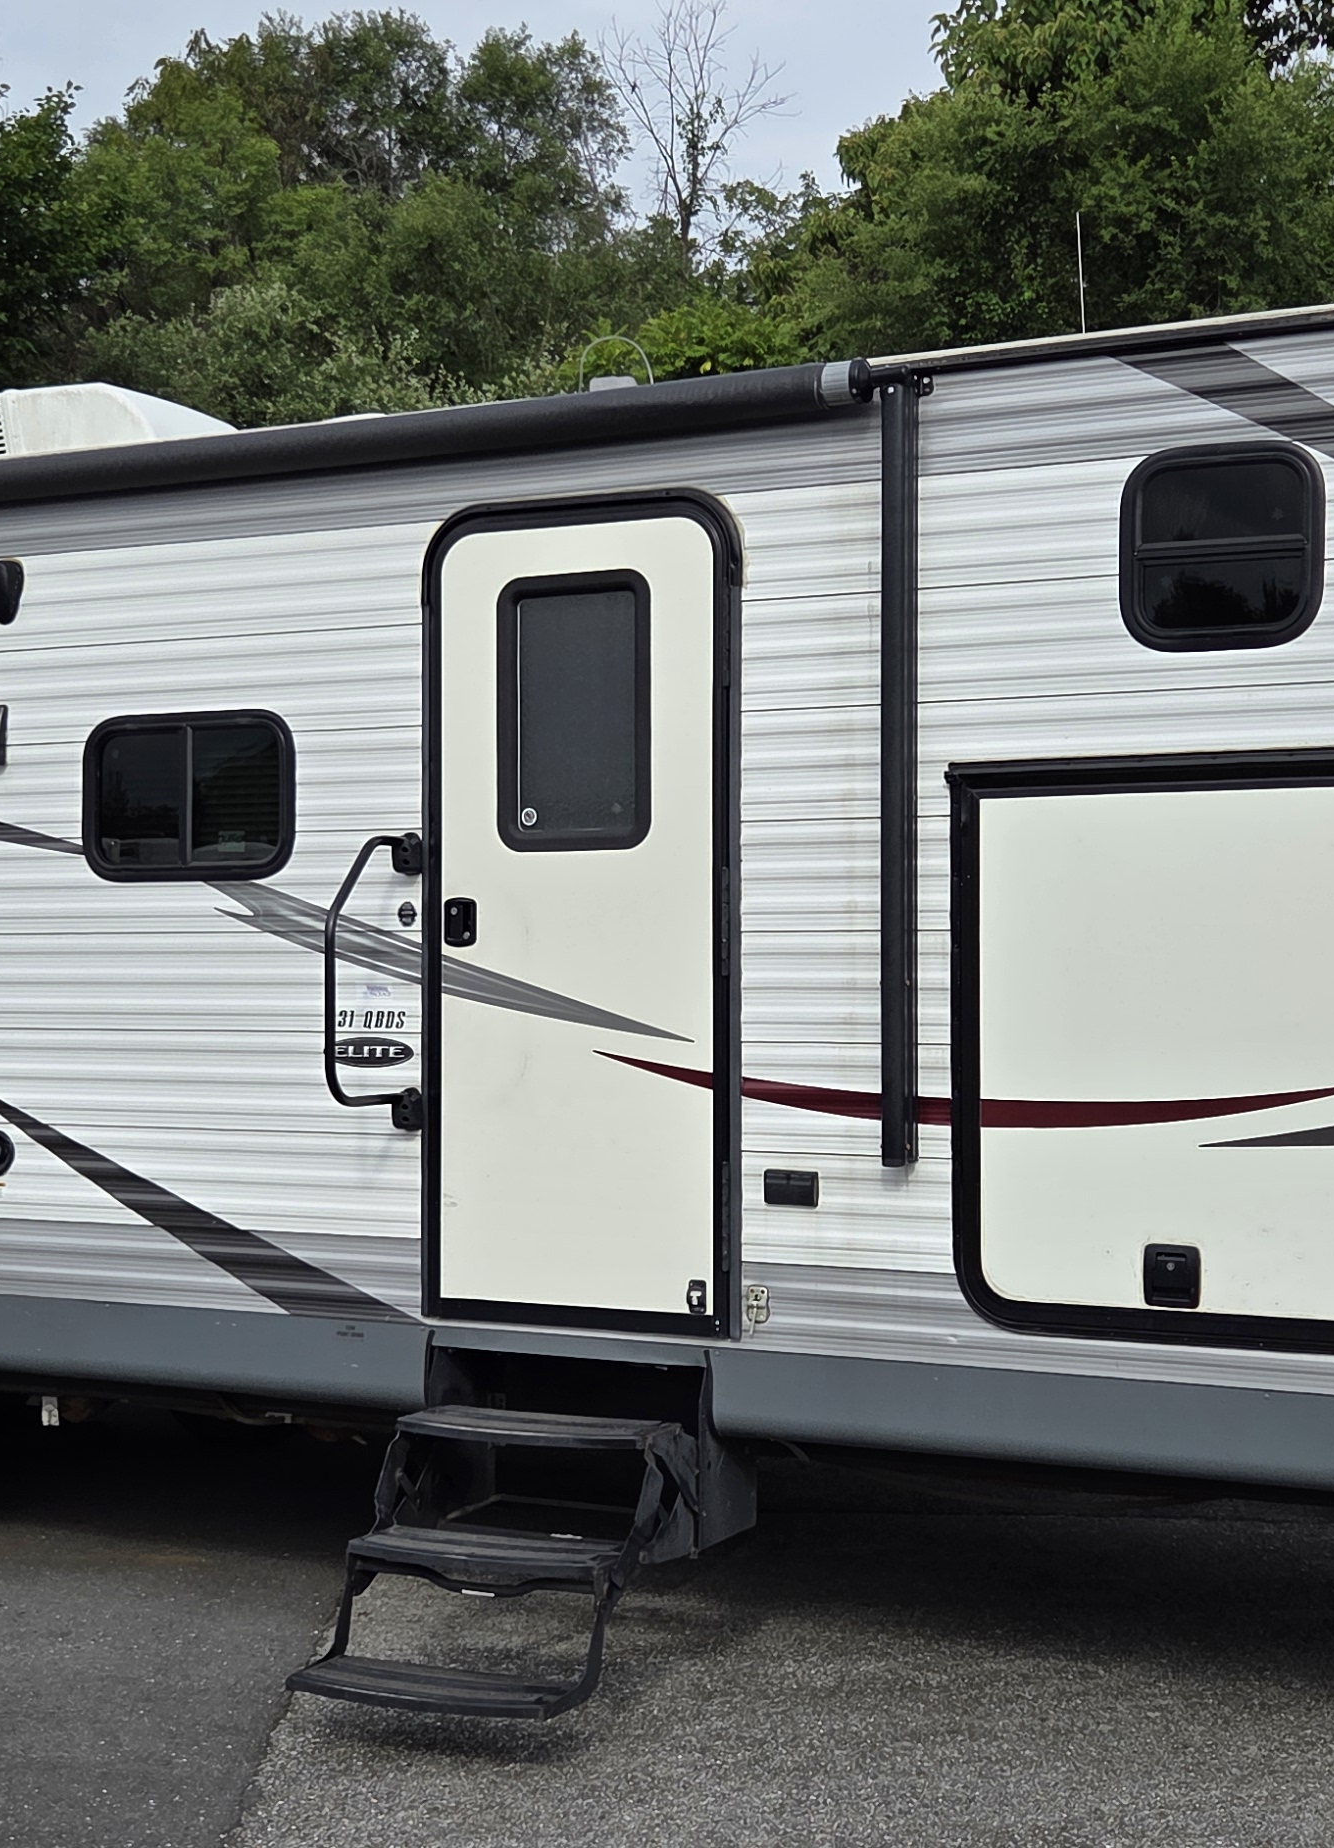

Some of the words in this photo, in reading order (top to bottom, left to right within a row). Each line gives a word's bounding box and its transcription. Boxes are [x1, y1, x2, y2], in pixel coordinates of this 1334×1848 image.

[337, 1010, 355, 1028] 31
[363, 1010, 406, 1029] QBDS
[335, 1045, 405, 1058] ELITE
